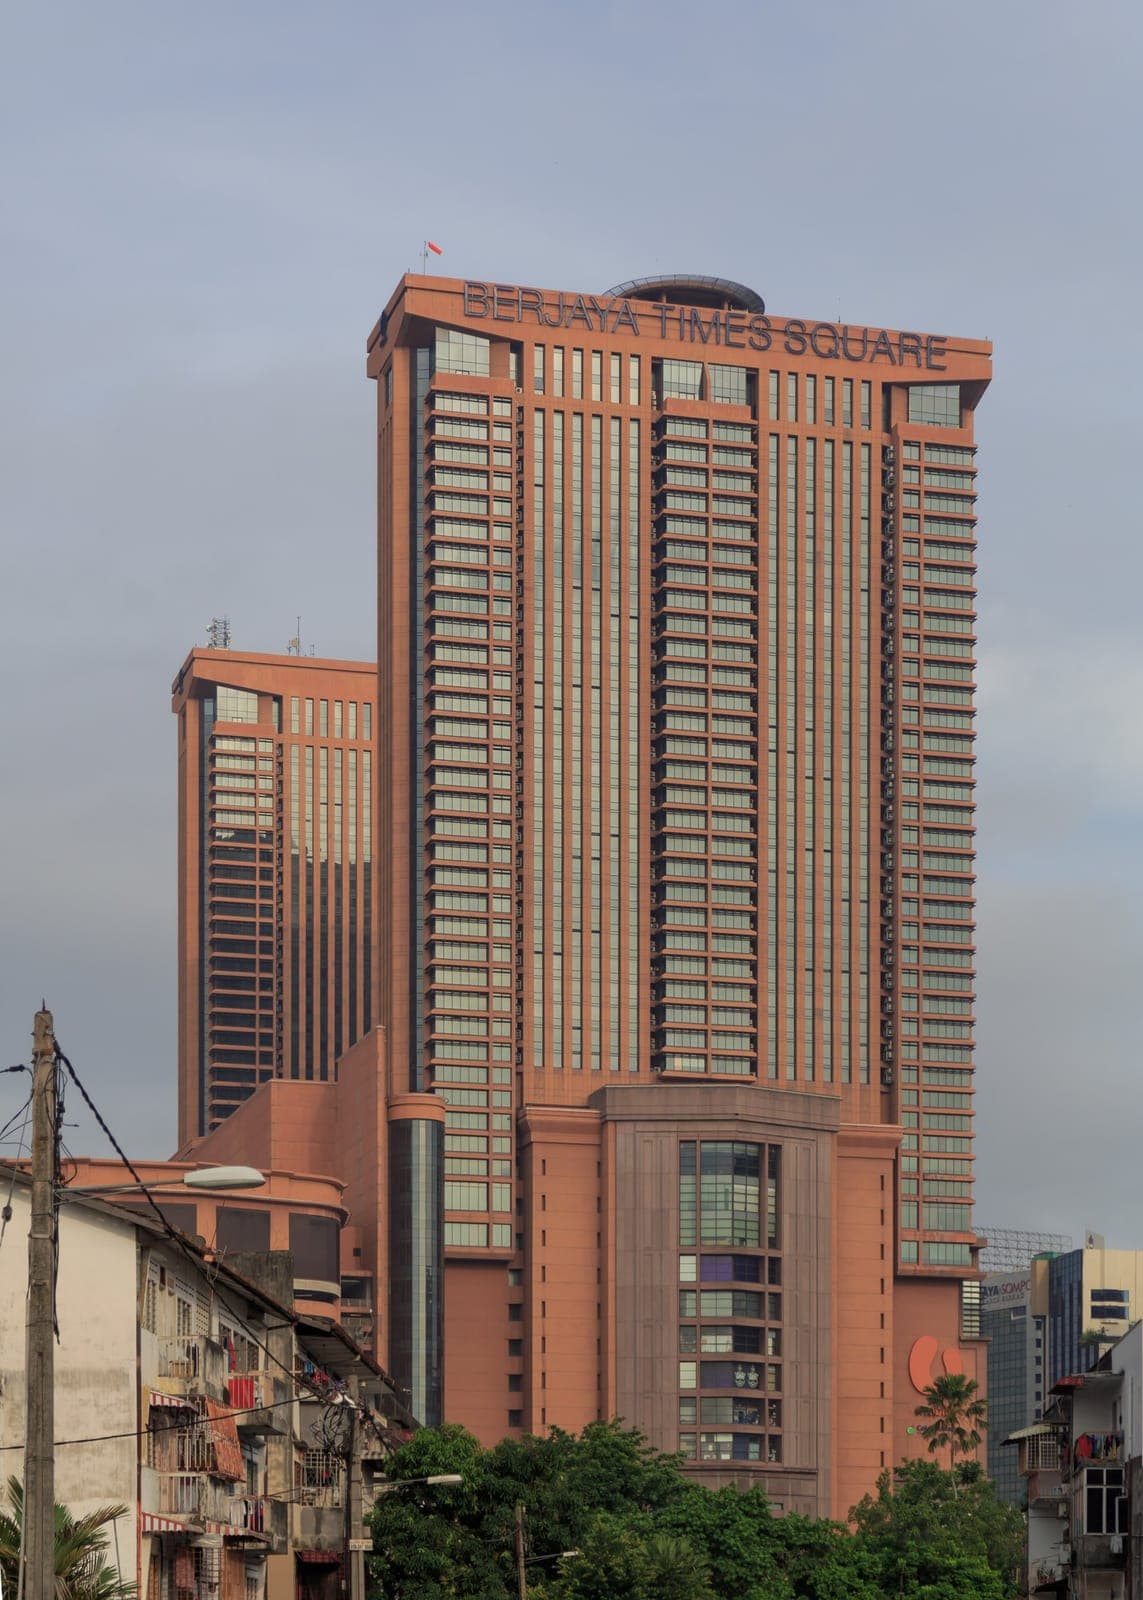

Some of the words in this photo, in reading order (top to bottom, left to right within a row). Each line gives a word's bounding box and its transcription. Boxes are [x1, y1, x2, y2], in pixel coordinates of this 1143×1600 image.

[463, 281, 640, 337] BERJAYA
[652, 303, 773, 351] TIMES
[784, 319, 948, 371] SQUARE
